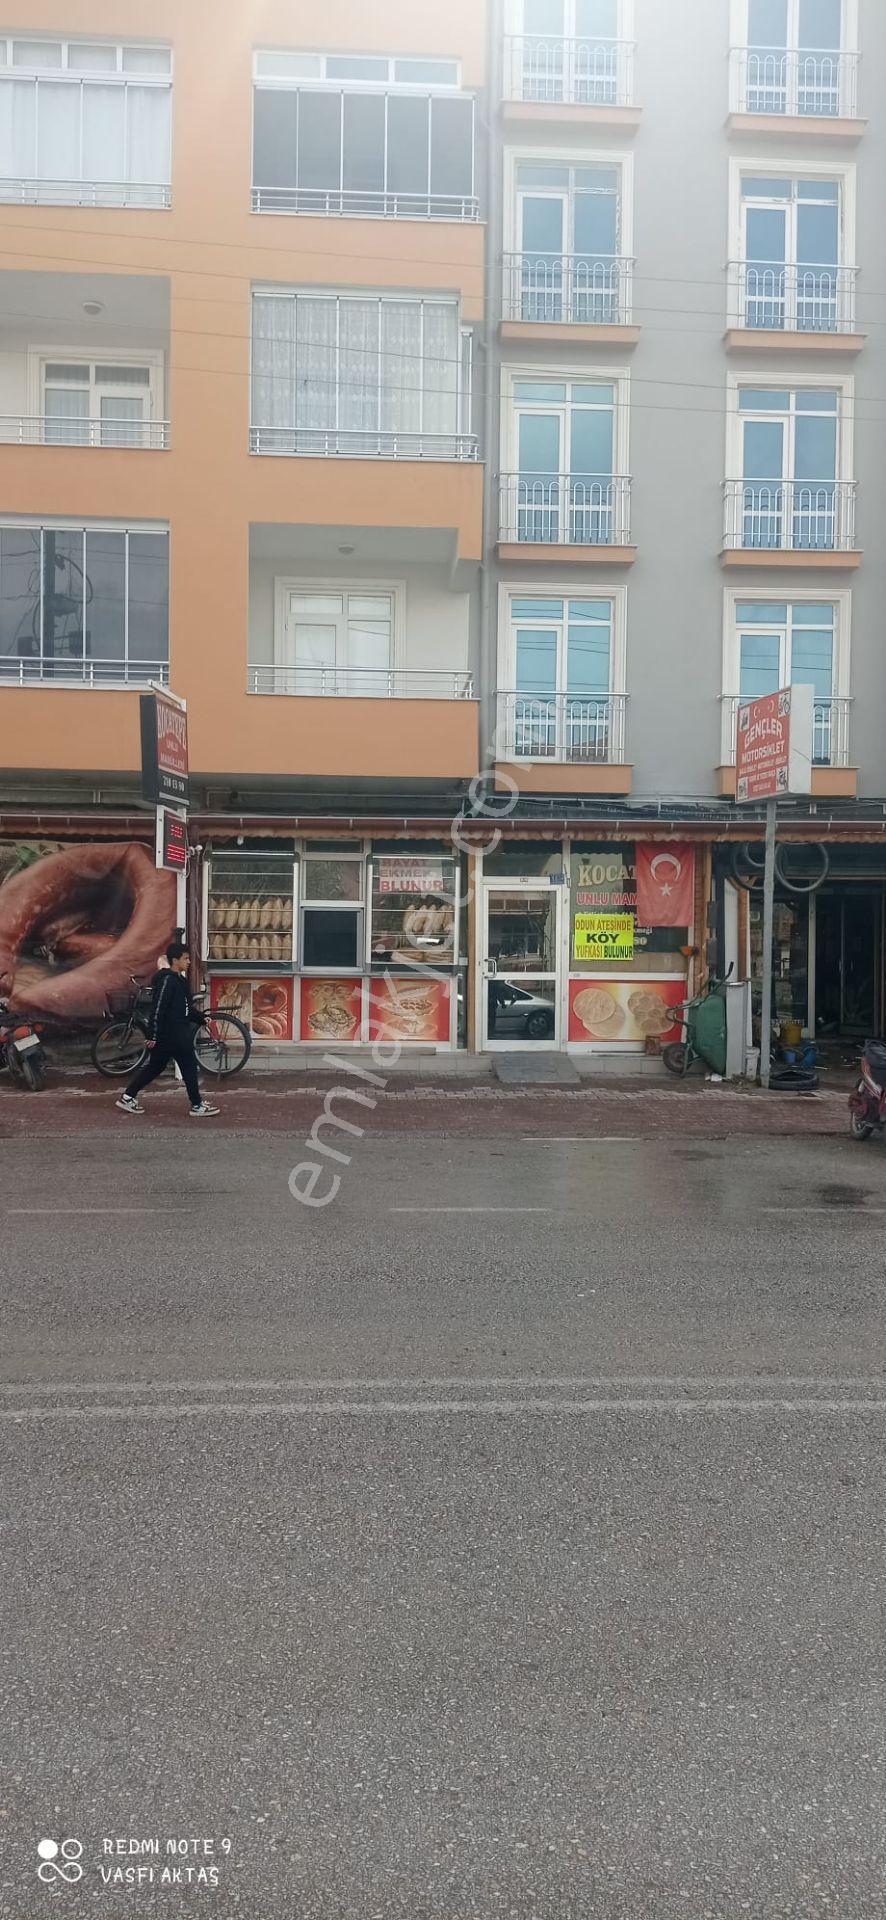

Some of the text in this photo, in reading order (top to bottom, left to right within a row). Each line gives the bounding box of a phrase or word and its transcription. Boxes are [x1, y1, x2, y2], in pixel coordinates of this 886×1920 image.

[744, 717, 783, 749] GENÇLER
[380, 880, 443, 892] BLUNUR
[576, 892, 609, 906] UNLU
[576, 919, 597, 931] ODUN
[597, 918, 631, 933] ATEŞİNDE
[586, 931, 620, 944] KÖY
[576, 945, 633, 958] YUFKASI BULUNUR
